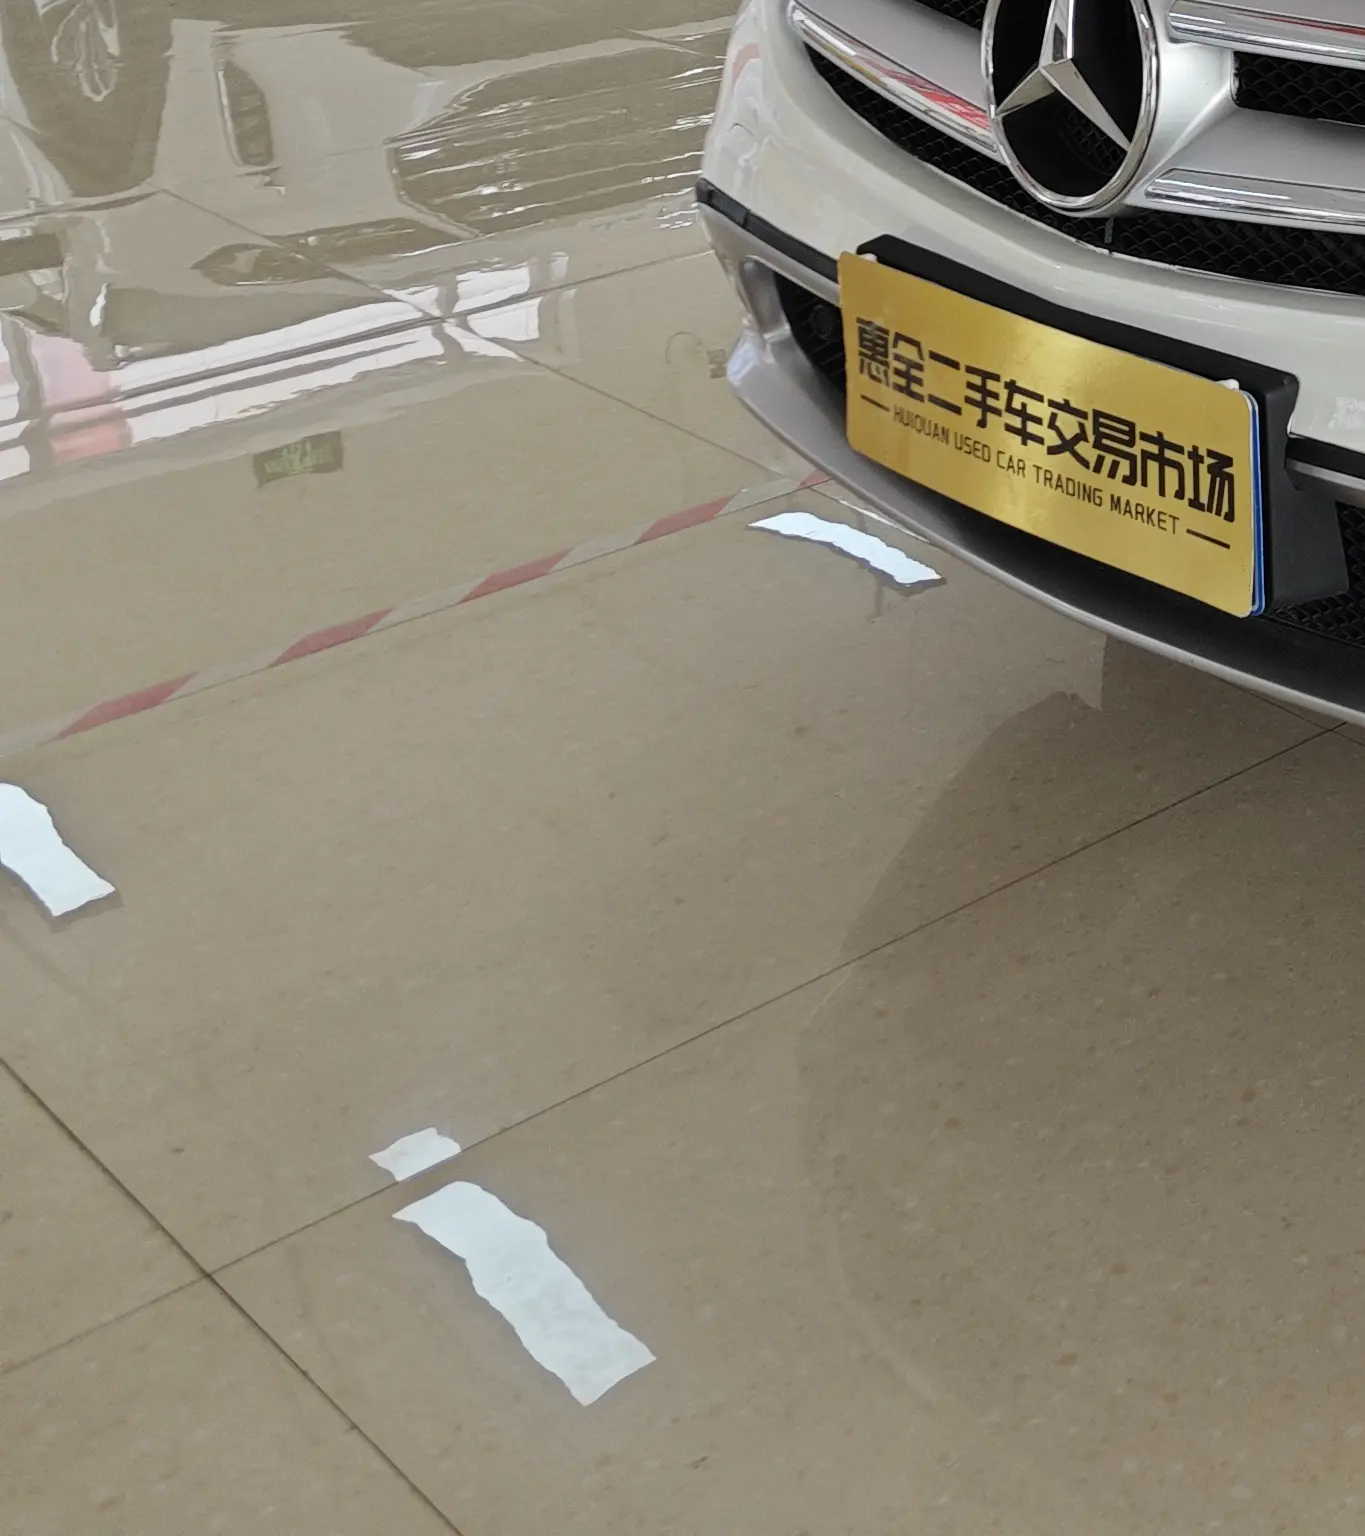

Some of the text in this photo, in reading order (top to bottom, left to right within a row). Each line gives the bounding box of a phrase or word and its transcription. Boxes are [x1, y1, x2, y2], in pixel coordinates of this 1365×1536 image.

[856, 317, 1236, 524] 惠全二手车交易市场
[892, 405, 1180, 535] HUIQUAN USED CAR TRADING MARKET
